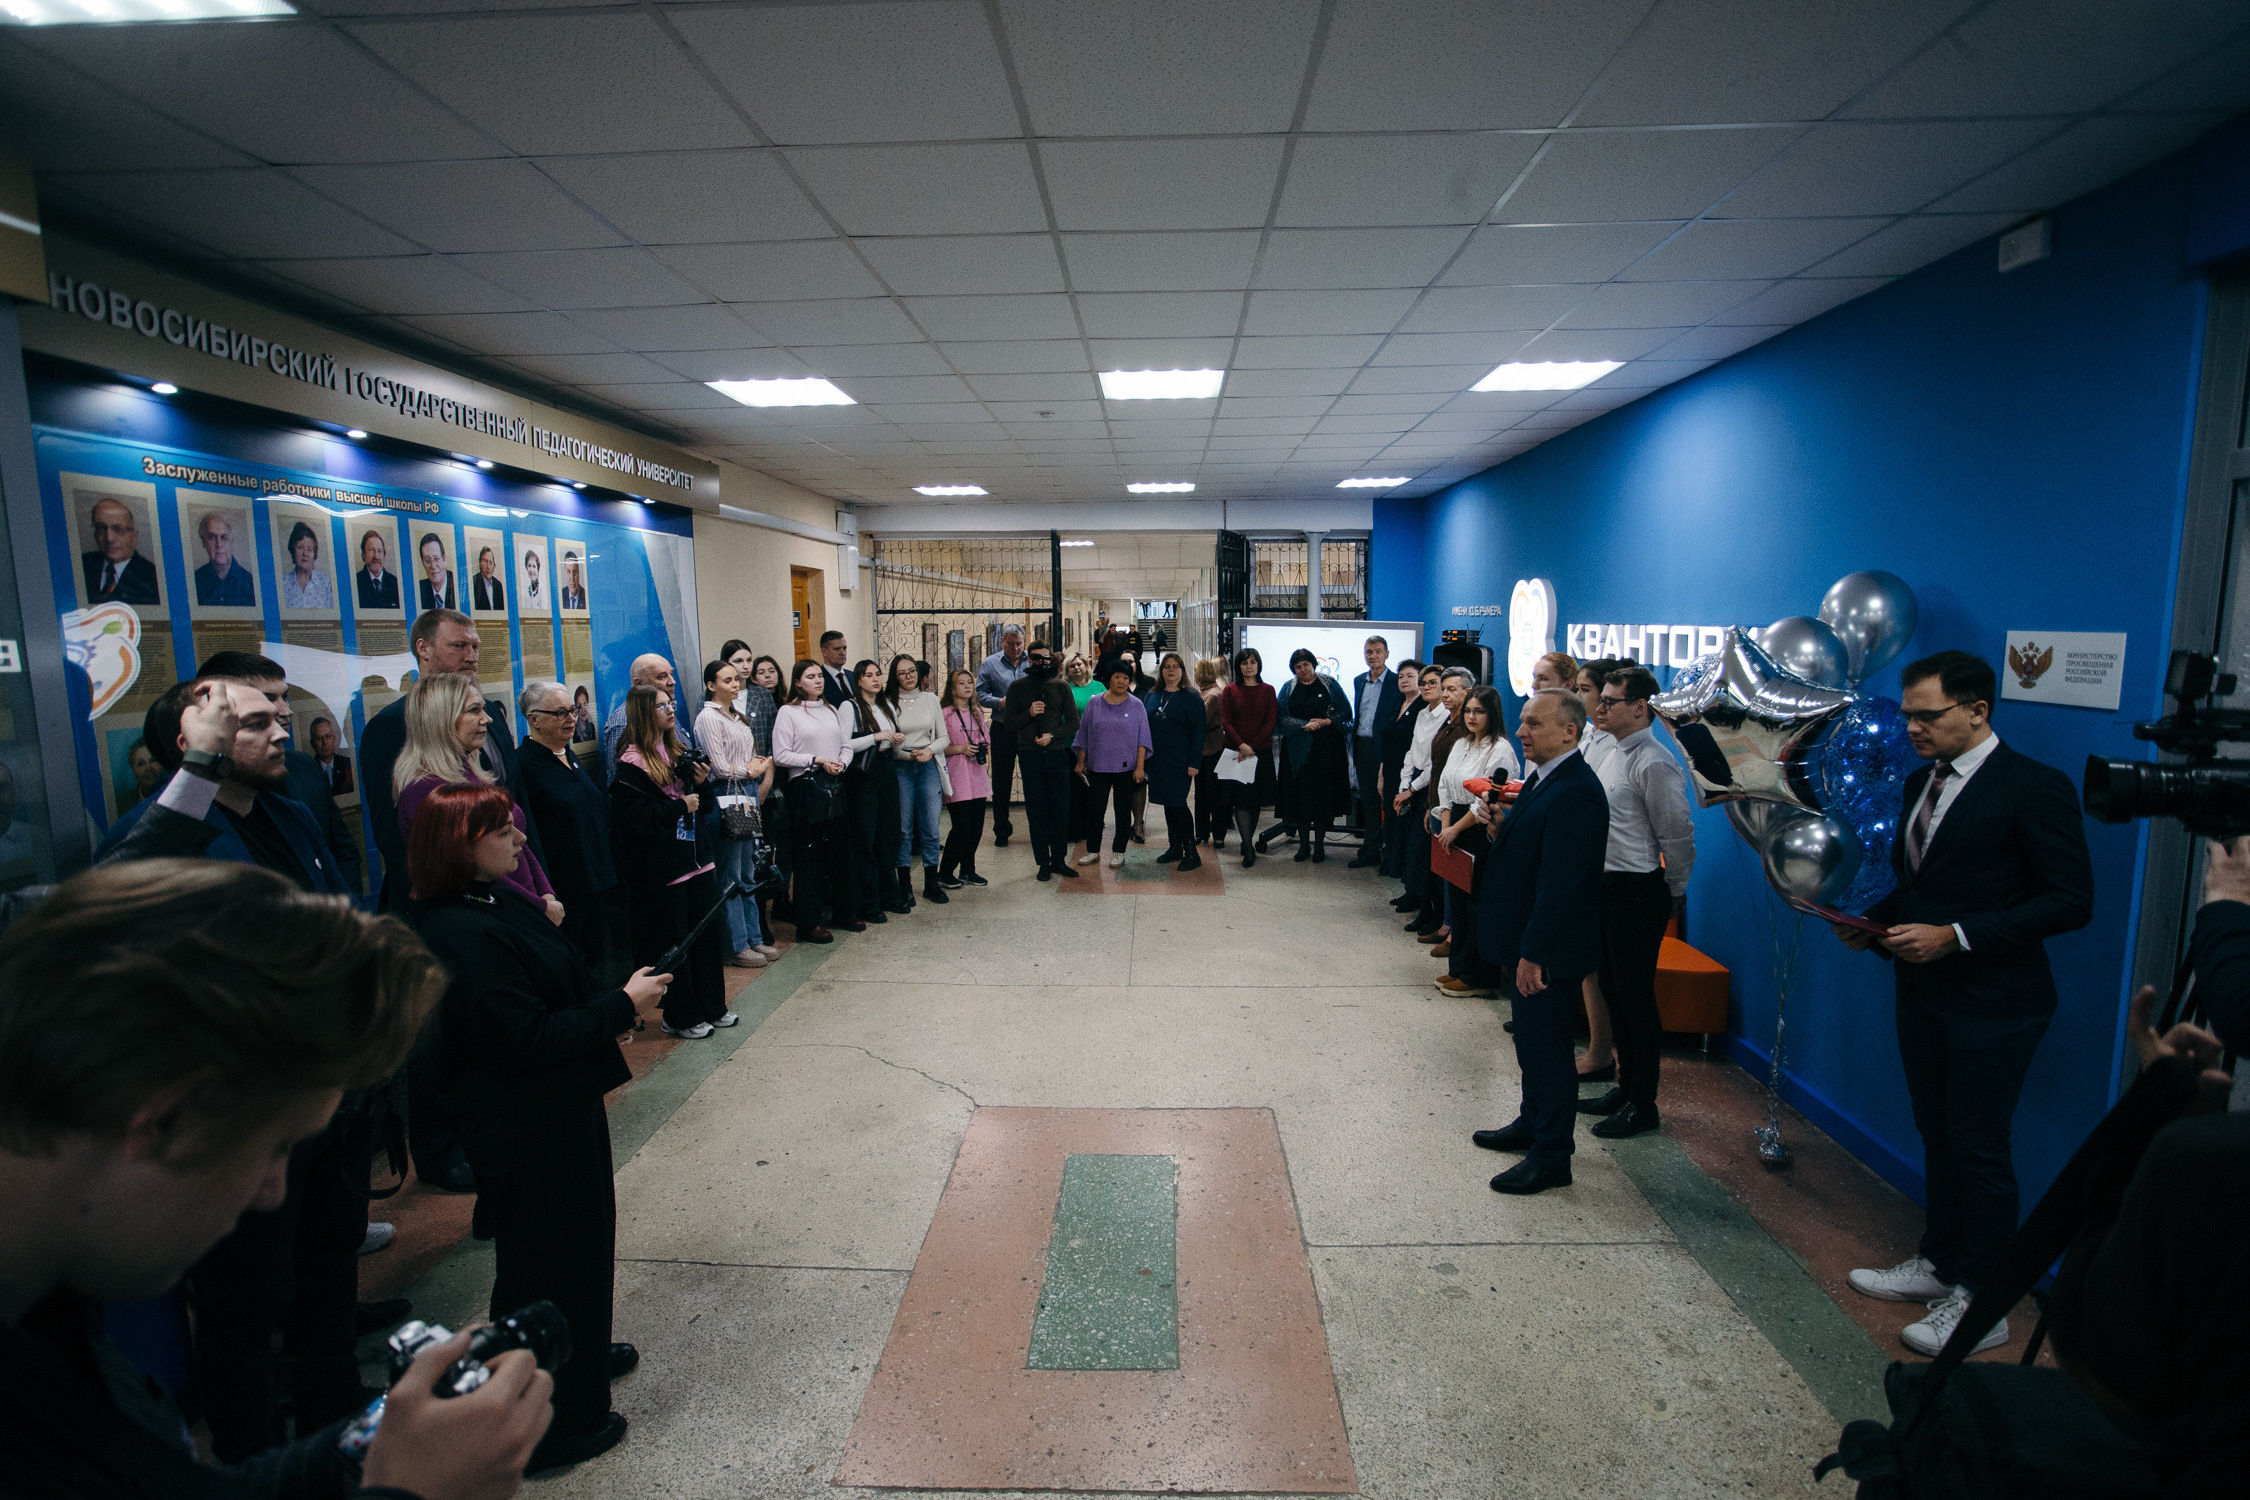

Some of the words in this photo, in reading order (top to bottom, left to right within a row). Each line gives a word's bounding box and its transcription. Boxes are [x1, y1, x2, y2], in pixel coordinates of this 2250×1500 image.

[49, 272, 339, 391] НОВОСИБИРСКИЙ
[345, 366, 528, 445] ГОСУДАРСТВЕННЫЙ
[532, 426, 634, 475] ПЕДАГОГИЧЕСКИЙ
[637, 456, 694, 490] УНИВЕРСИТЕТ
[142, 457, 258, 489] Заслуженные
[262, 479, 331, 500] работники
[336, 489, 383, 507] высшей
[386, 497, 422, 513] школы
[424, 501, 440, 514] РФ
[1567, 623, 1758, 668] КВАНТОР
[2067, 652, 2118, 660] МИНИСТЕРСТВО
[2066, 660, 2114, 669] ПРОСВЕЩЕНИЯ
[2065, 668, 2107, 676] РОССИЙСКОЙ
[2064, 676, 2102, 684] ФЕДЕРАЦИИ
